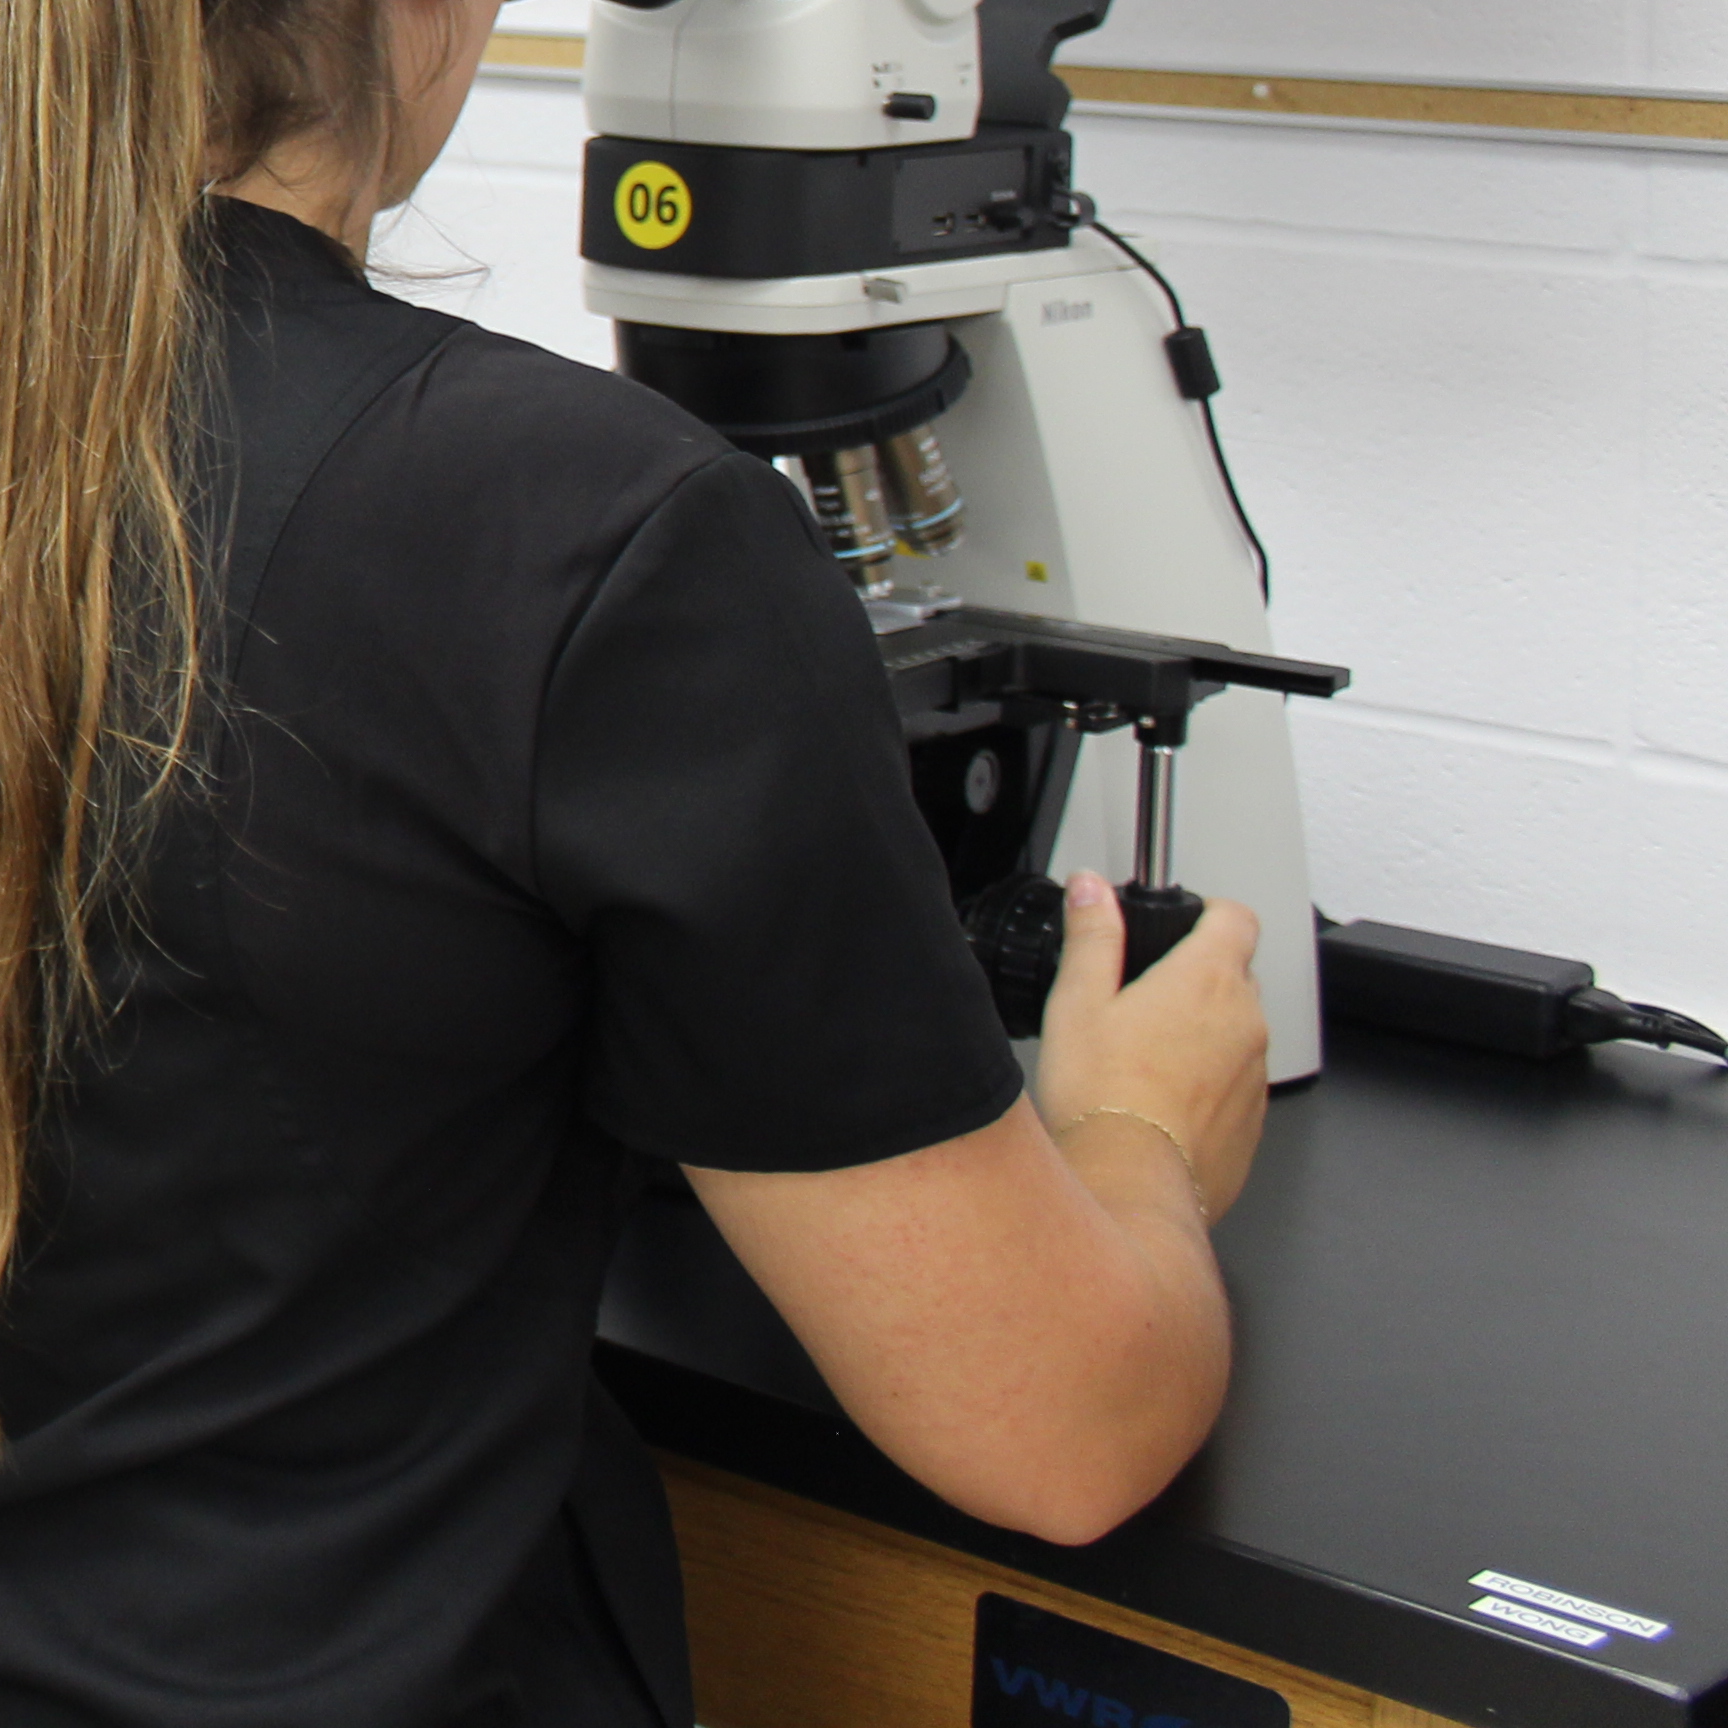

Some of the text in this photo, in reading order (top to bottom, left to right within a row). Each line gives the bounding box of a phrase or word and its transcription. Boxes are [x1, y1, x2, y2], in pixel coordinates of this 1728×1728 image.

[630, 183, 678, 224] 06
[1486, 1576, 1656, 1633] ROBINSON
[1492, 1601, 1590, 1640] WONG
